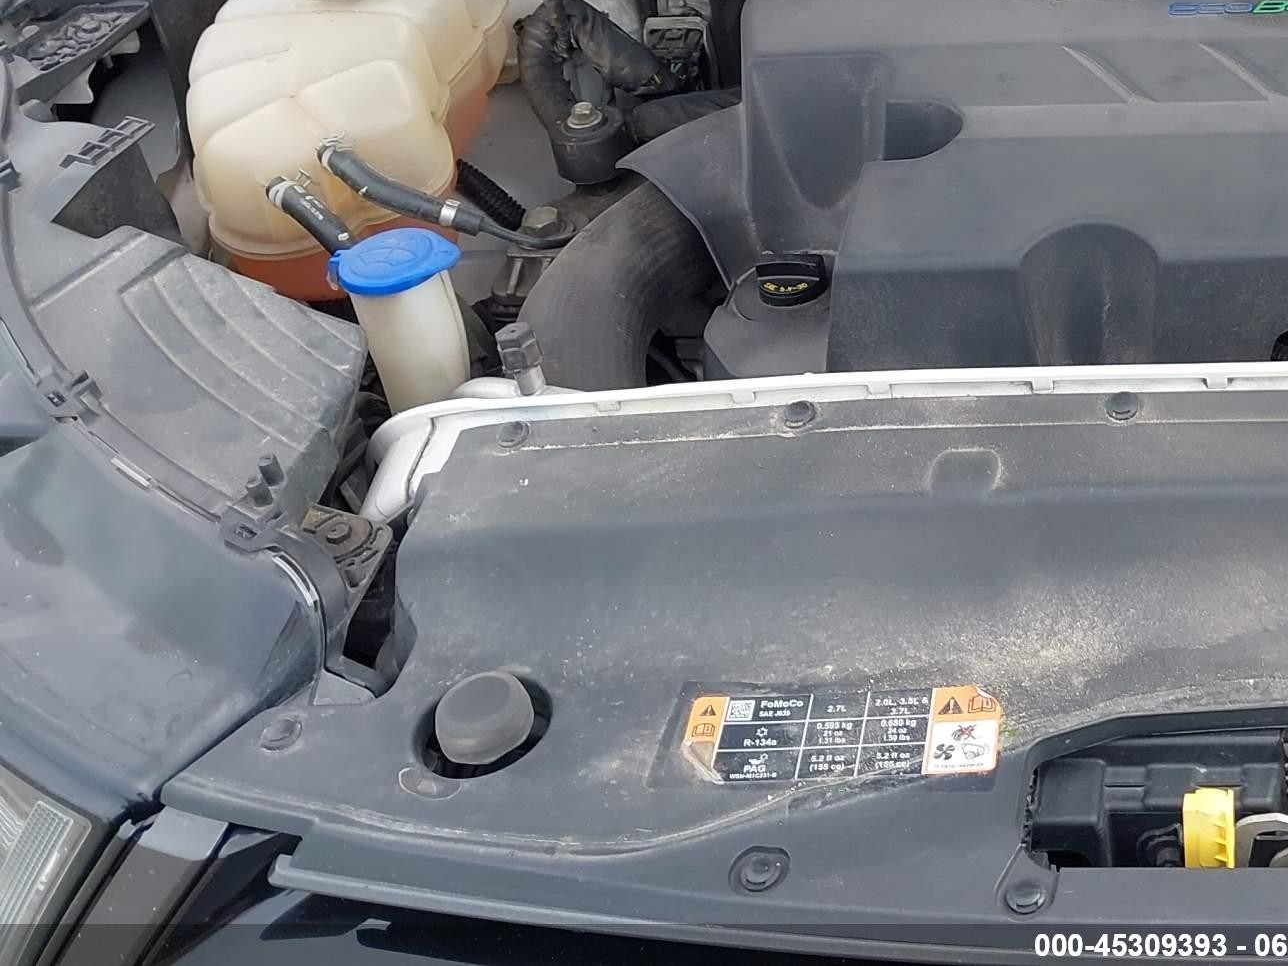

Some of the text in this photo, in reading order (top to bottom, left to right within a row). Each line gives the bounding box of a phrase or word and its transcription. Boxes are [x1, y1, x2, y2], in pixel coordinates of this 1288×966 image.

[760, 699, 804, 709] FoMoCo
[898, 697, 919, 705] 3.5L
[826, 704, 847, 713] 2.7L
[889, 707, 911, 715] 3.7L
[841, 721, 853, 731] kg
[905, 718, 917, 728] kg
[743, 739, 777, 747] R-134a
[810, 754, 825, 762] 5.2
[875, 752, 890, 760] 5.2
[743, 764, 766, 773] PAG
